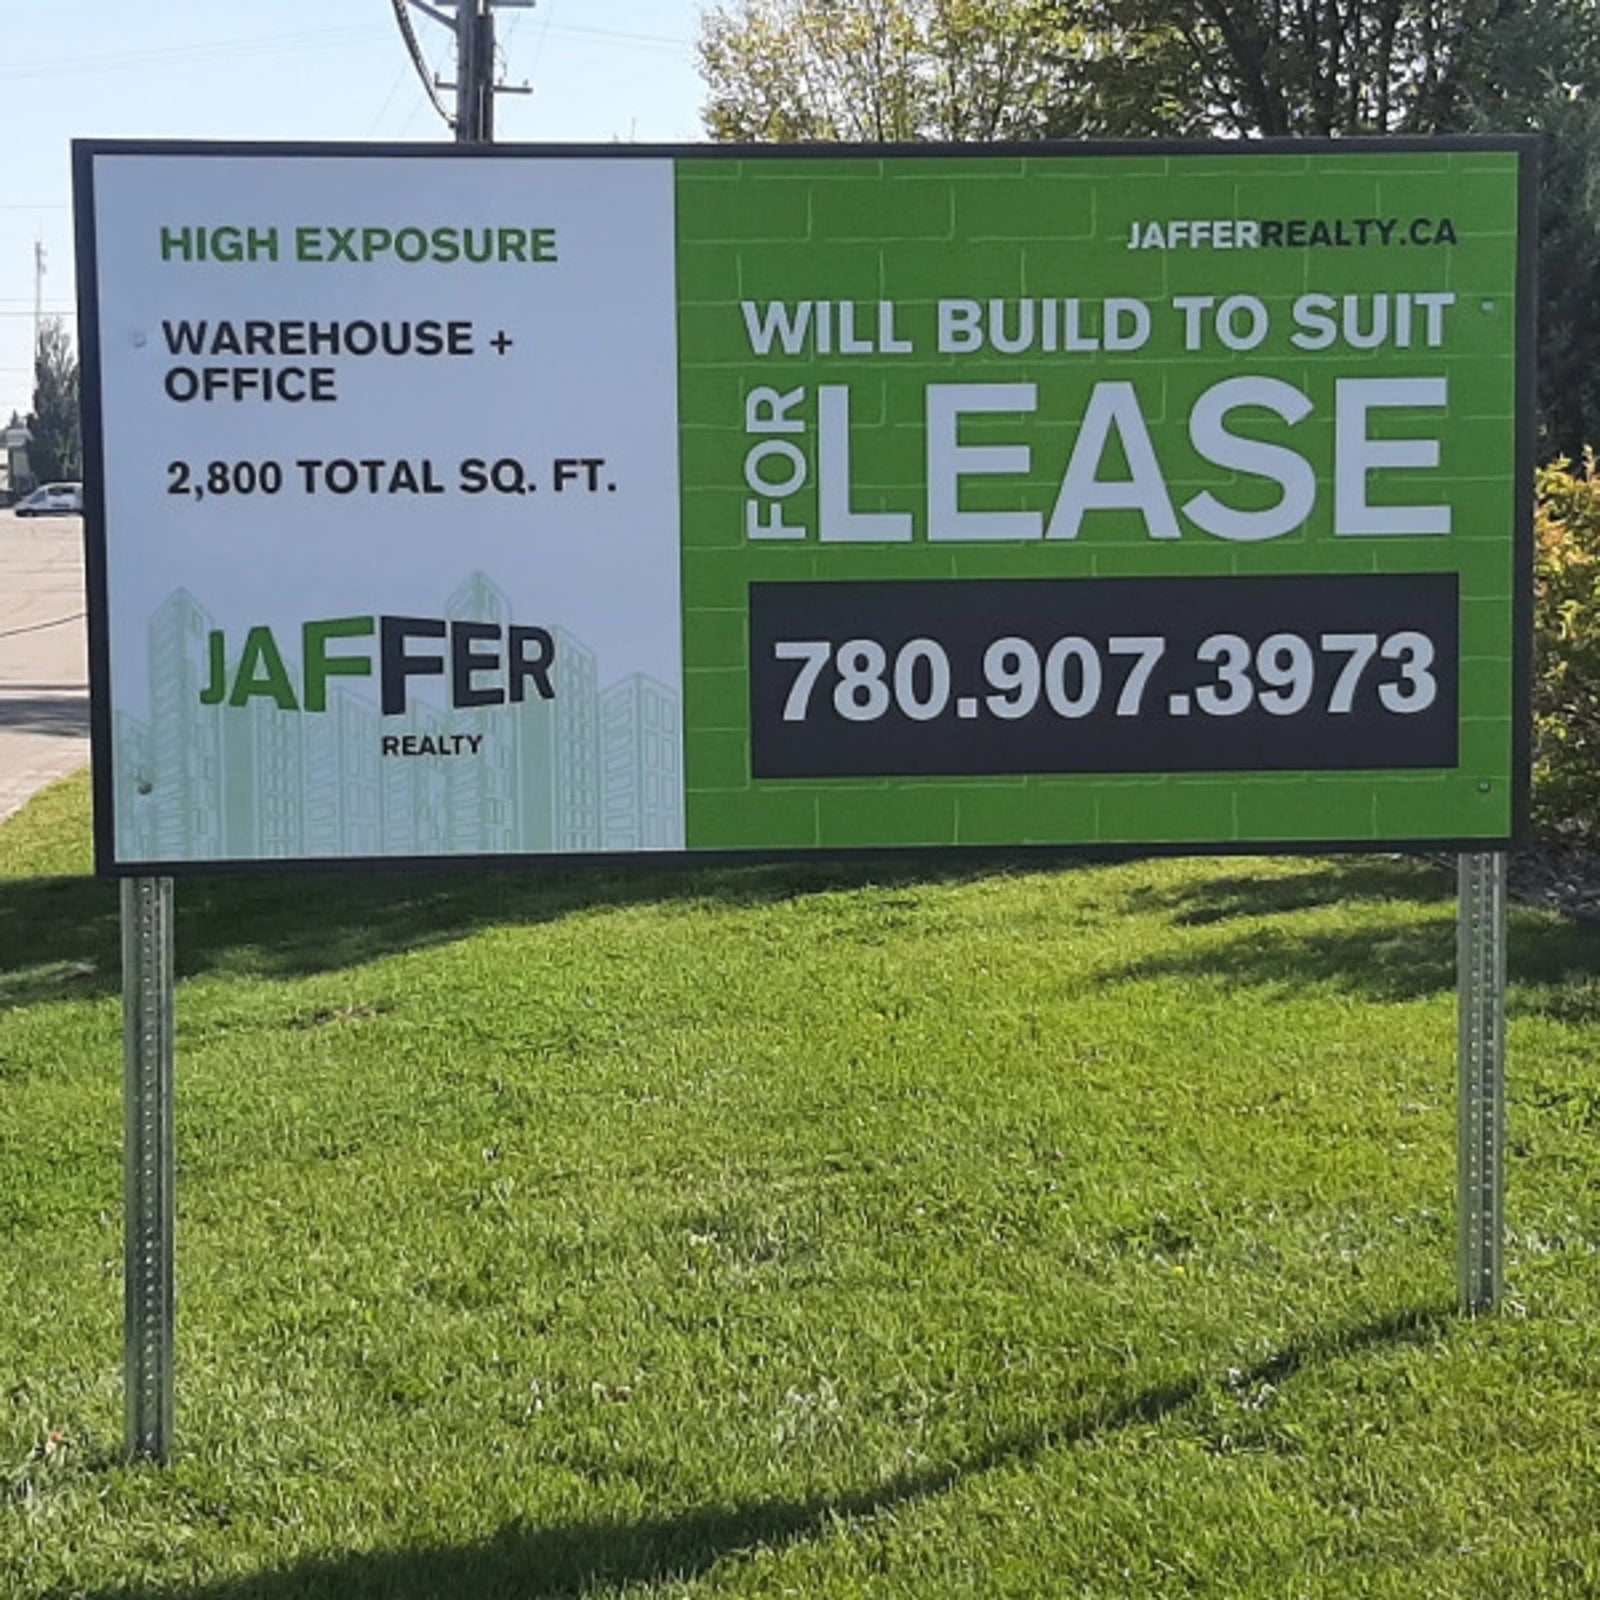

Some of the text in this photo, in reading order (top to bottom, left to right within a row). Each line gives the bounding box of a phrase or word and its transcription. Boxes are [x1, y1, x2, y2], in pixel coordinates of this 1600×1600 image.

[161, 227, 558, 263] HIGH EXPOSURE
[1127, 217, 1457, 251] JAFFERREALTY.CA
[163, 321, 474, 356] WAREHOUSE
[742, 292, 1455, 355] WILL BUILD TO SUIT
[164, 367, 338, 402] OFFICE
[167, 459, 617, 499] 2,800 TOTAL SQ. FT.
[745, 386, 807, 540] FOR
[817, 376, 1452, 543] LEASE
[200, 615, 556, 715] JAFFER
[775, 632, 1437, 722] 780.907.3973
[381, 735, 482, 756] REALTY
